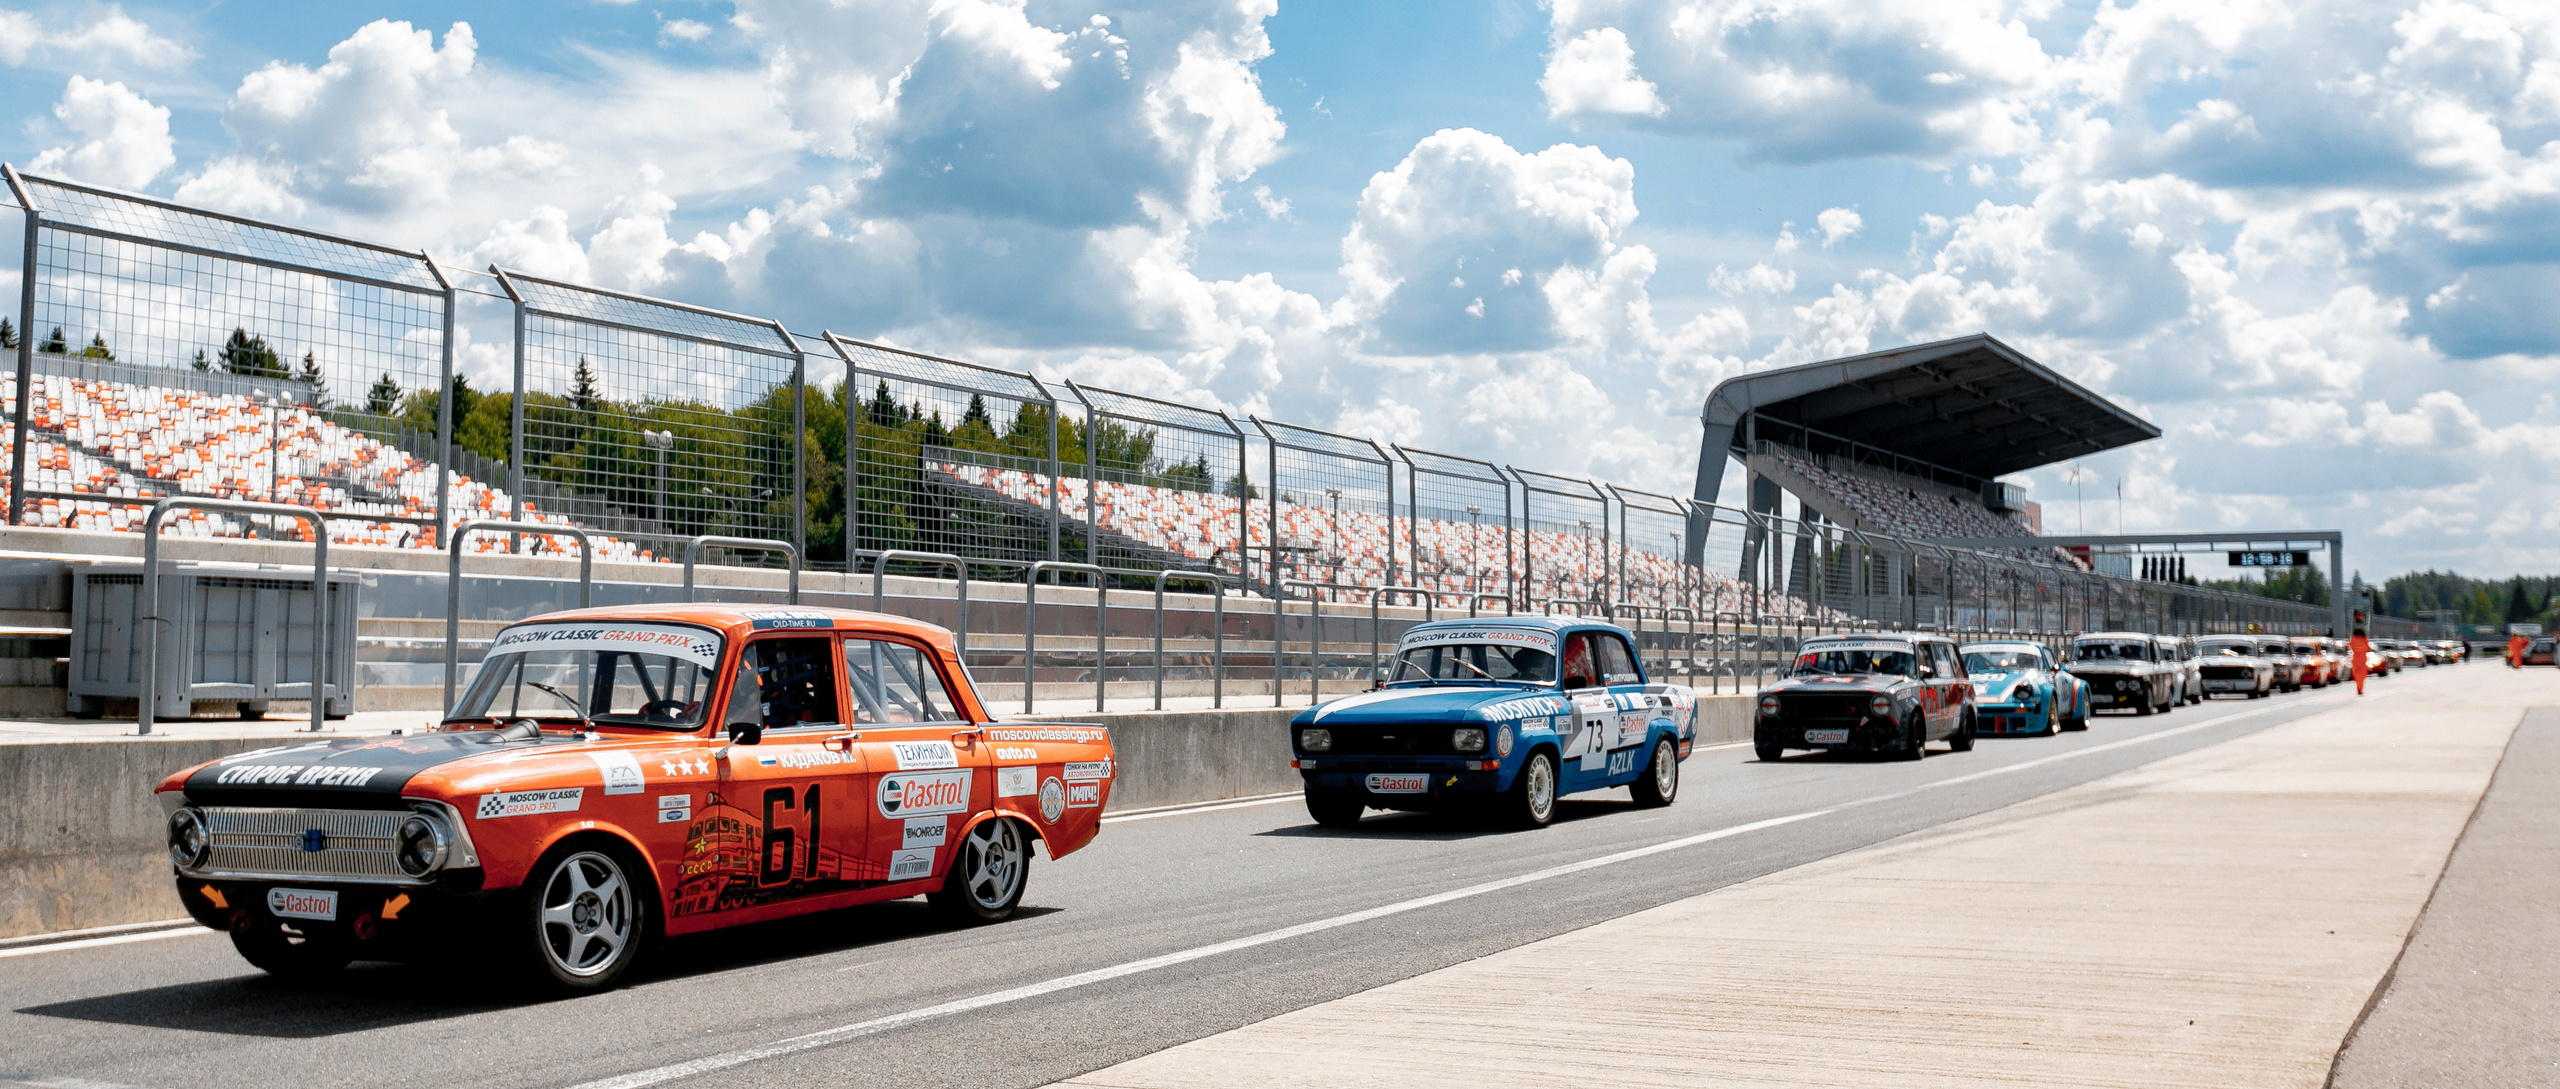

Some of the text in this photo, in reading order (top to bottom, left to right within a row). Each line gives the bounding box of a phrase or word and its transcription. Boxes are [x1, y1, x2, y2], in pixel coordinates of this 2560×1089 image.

[500, 629, 694, 648] MOSCOW CLASSIC GRAND PRIX
[1407, 631, 1550, 646] MOSCOW CLASSIC GRAND PRIX
[1481, 696, 1559, 723] MOSKVICH
[990, 728, 1103, 743] moscowclassicgp.ru
[1586, 719, 1604, 754] 73
[1815, 731, 1845, 741] Castrol
[778, 750, 841, 769] КАДАКОВ
[895, 743, 953, 761] ТЕХИНКОМ
[996, 746, 1037, 760] auto.ru
[1608, 750, 1635, 776] AZLK
[217, 765, 383, 787] СТАРОЕ ВРЕМЯ
[1382, 777, 1424, 790] Castrol
[508, 789, 580, 804] MOSCOW CLASSIC
[903, 777, 963, 809] Castrol
[1070, 785, 1097, 802] МАТЧ!
[506, 801, 557, 814] GRAND PRIX
[761, 783, 821, 887] 61
[907, 825, 944, 838] MONROE
[286, 893, 331, 914] Castrol
